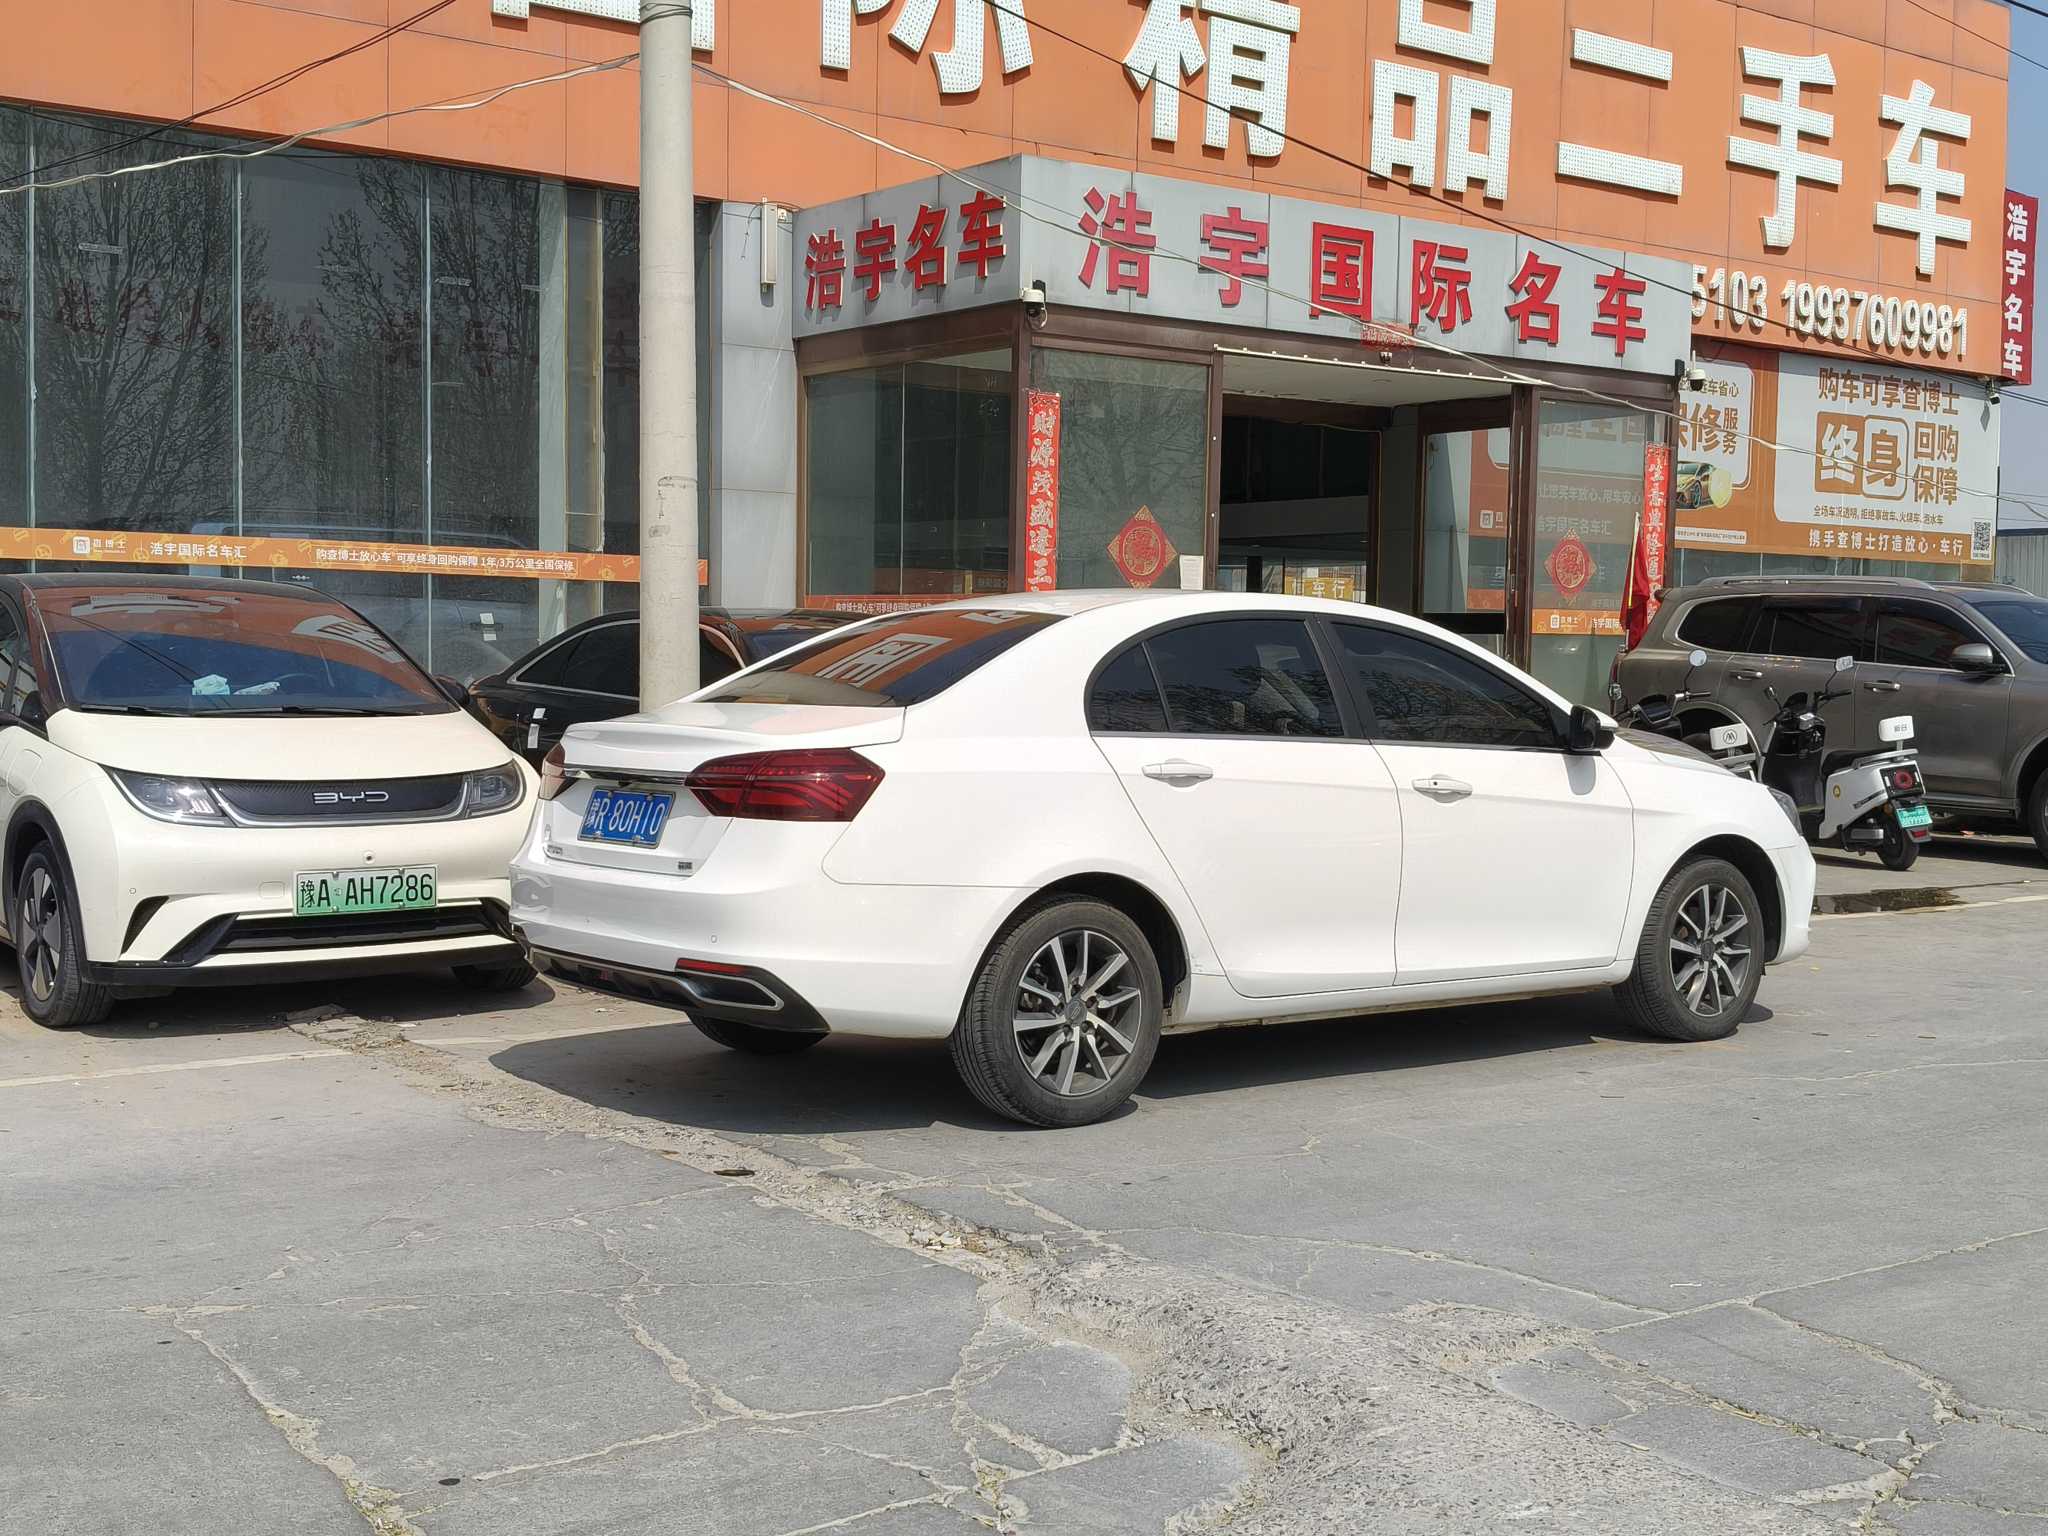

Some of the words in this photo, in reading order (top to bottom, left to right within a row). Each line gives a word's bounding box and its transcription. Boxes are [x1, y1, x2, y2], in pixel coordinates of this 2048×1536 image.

[804, 191, 1007, 311] 浩宇名车
[1078, 185, 1647, 357] 浩宇国际名车
[2003, 202, 2029, 377] 浩宇名车
[1780, 279, 1968, 356] 19937609981
[1818, 366, 1960, 416] 购车可享查博士
[1819, 422, 1902, 488] 终身
[1913, 420, 1959, 464] 回购
[1912, 463, 1959, 506] 保障
[150, 541, 248, 559] 浩宇国际名车汇
[313, 791, 390, 804] BYD
[344, 873, 434, 906] AH7286
